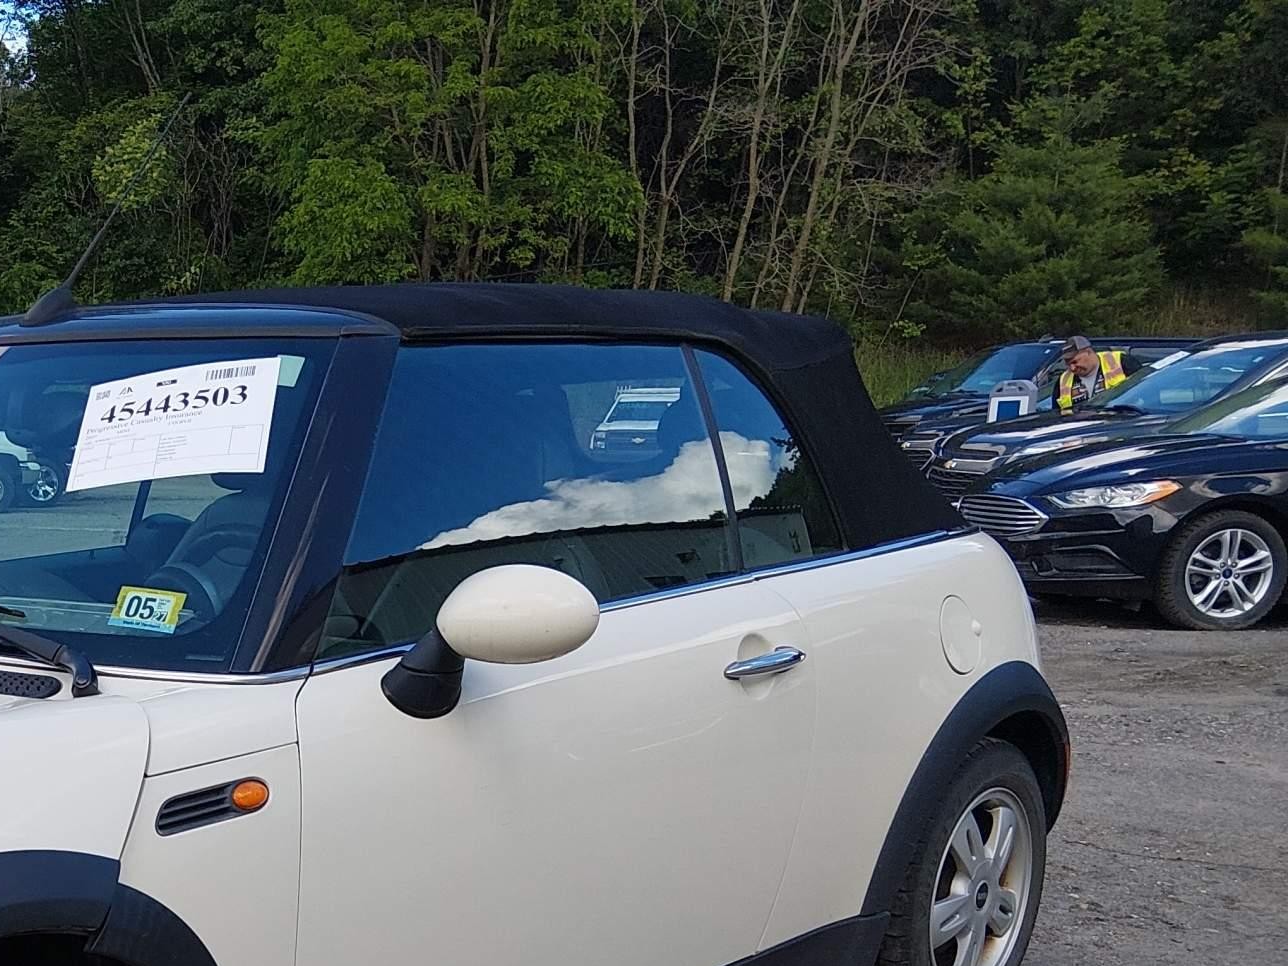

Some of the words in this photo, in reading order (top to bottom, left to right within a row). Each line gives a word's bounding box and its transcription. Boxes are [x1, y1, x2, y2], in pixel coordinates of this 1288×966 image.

[100, 384, 248, 424] 45443503
[165, 410, 203, 421] Insurance
[125, 595, 157, 620] 05
